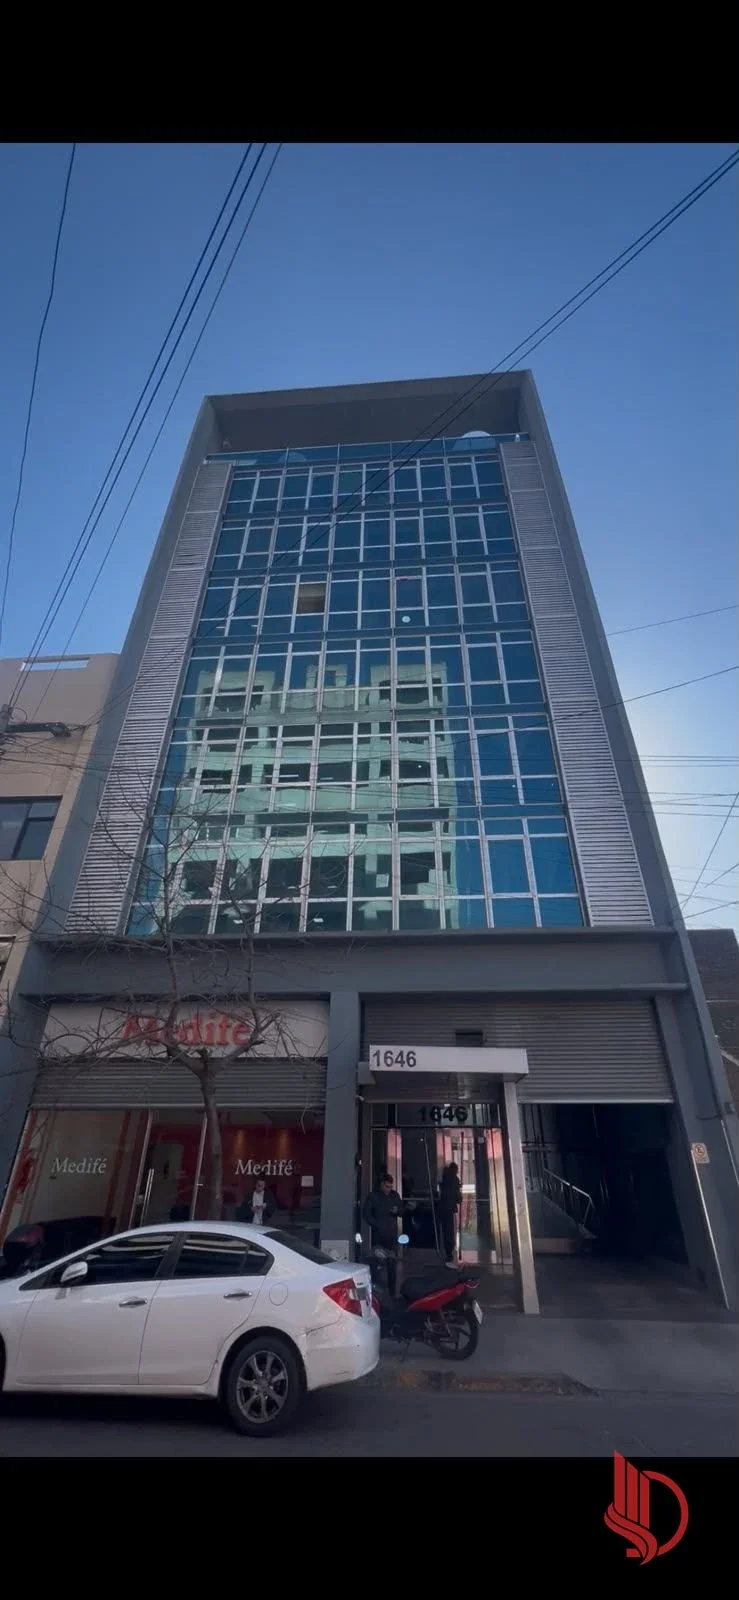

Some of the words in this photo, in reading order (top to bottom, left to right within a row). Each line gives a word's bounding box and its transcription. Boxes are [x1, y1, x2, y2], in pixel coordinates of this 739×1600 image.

[120, 1010, 250, 1047] Mdifé
[372, 1050, 417, 1068] 1646
[418, 1105, 468, 1122] 1646
[50, 1157, 107, 1174] Medifé
[235, 1159, 293, 1176] Medifé
